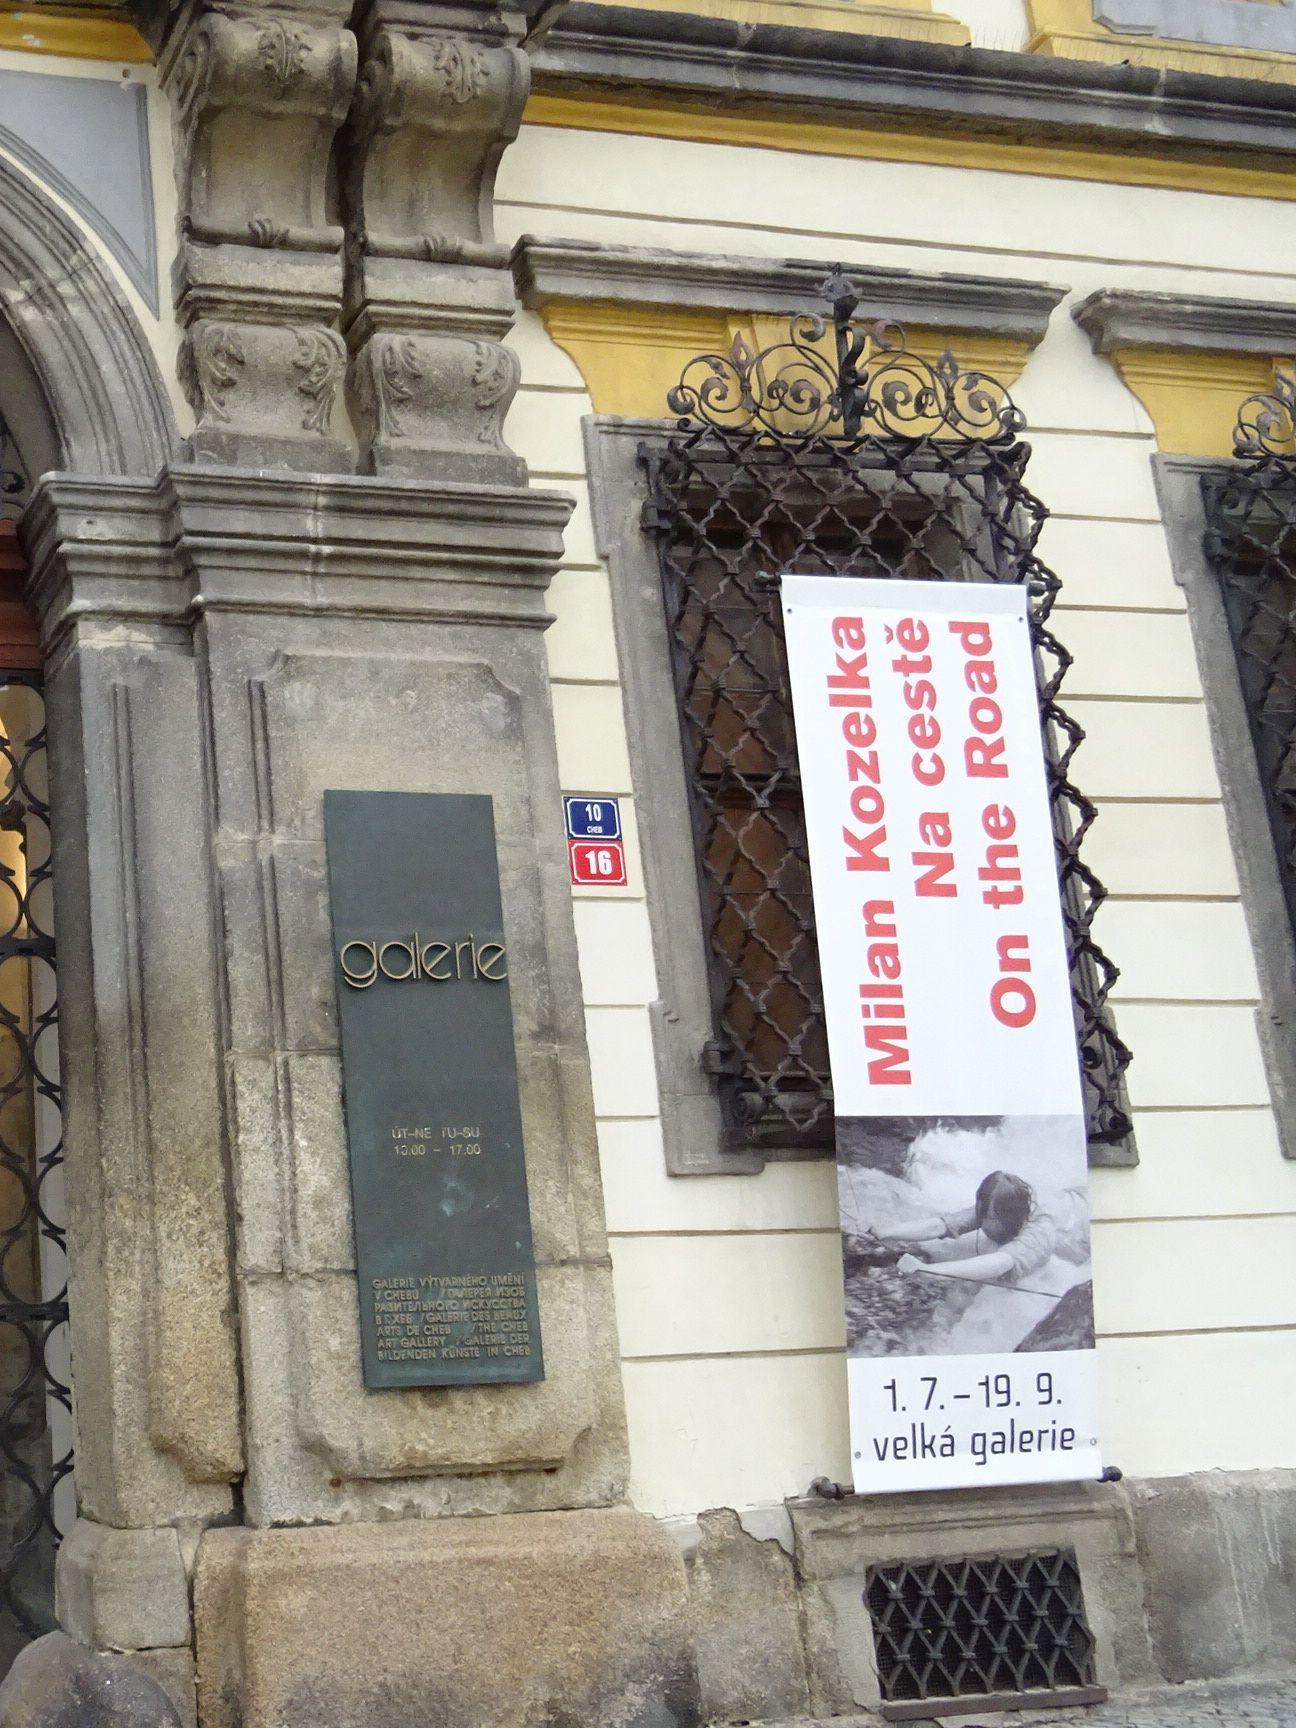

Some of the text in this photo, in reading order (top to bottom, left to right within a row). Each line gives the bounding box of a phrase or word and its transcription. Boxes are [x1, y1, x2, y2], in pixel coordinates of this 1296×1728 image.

[884, 616, 958, 898] Na cestě
[585, 803, 602, 822] 10
[586, 825, 603, 834] CHEB
[948, 620, 1037, 1029] On the Road
[827, 615, 912, 1086] Milan Kozelka
[584, 850, 613, 875] 16
[340, 931, 508, 989] galerie
[372, 1277, 416, 1290] GALERIE
[423, 1323, 452, 1335] CHEB
[400, 1336, 446, 1348] GALLERY
[504, 1345, 532, 1357] CHEB
[873, 1418, 1076, 1466] velká galerie
